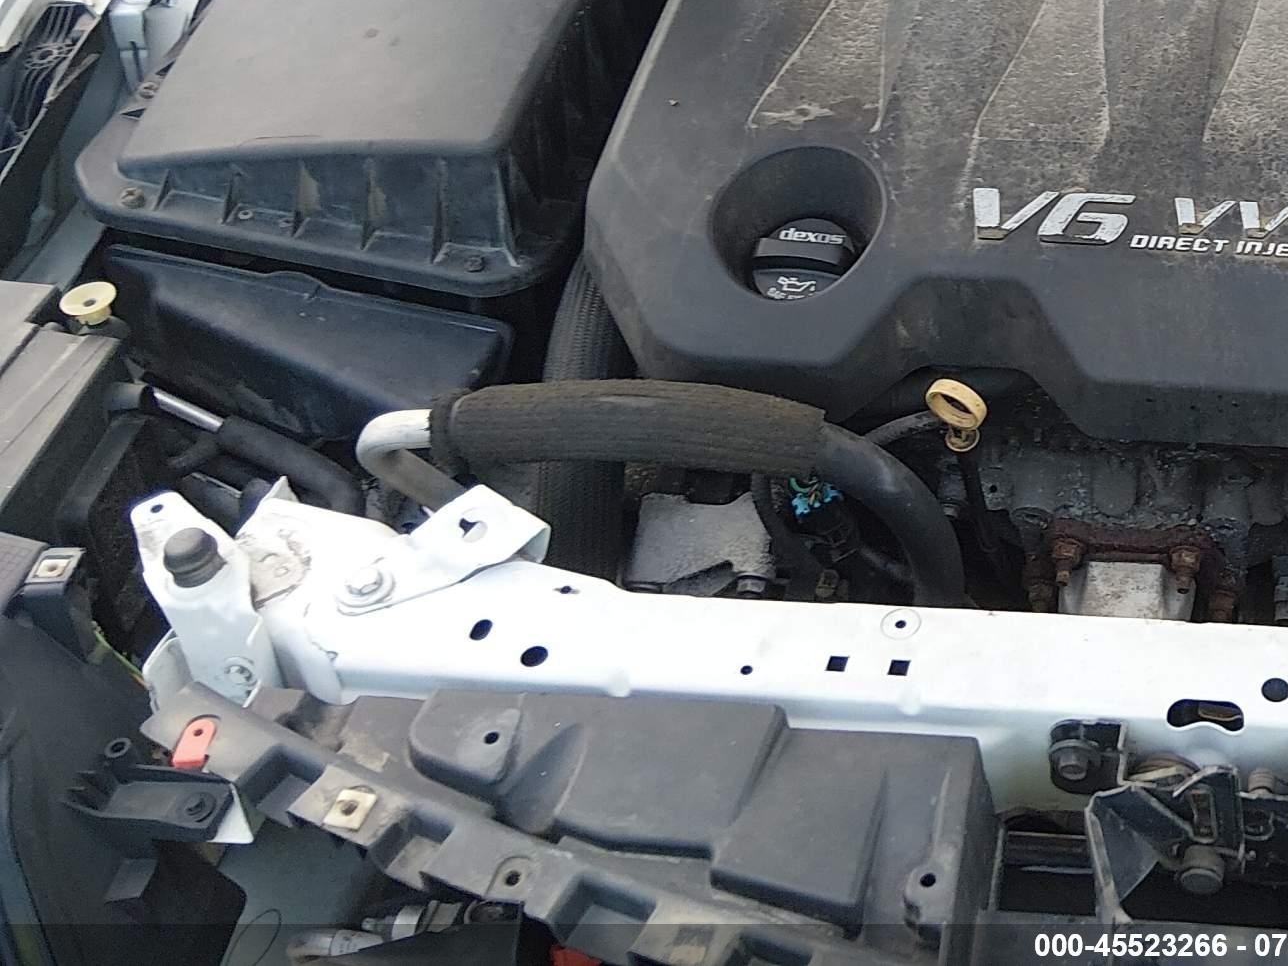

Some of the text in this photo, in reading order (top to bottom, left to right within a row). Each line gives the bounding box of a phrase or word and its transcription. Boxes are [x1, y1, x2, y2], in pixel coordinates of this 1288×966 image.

[973, 187, 1136, 245] V6
[779, 227, 847, 245] dexos
[1129, 234, 1229, 253] DIRECT
